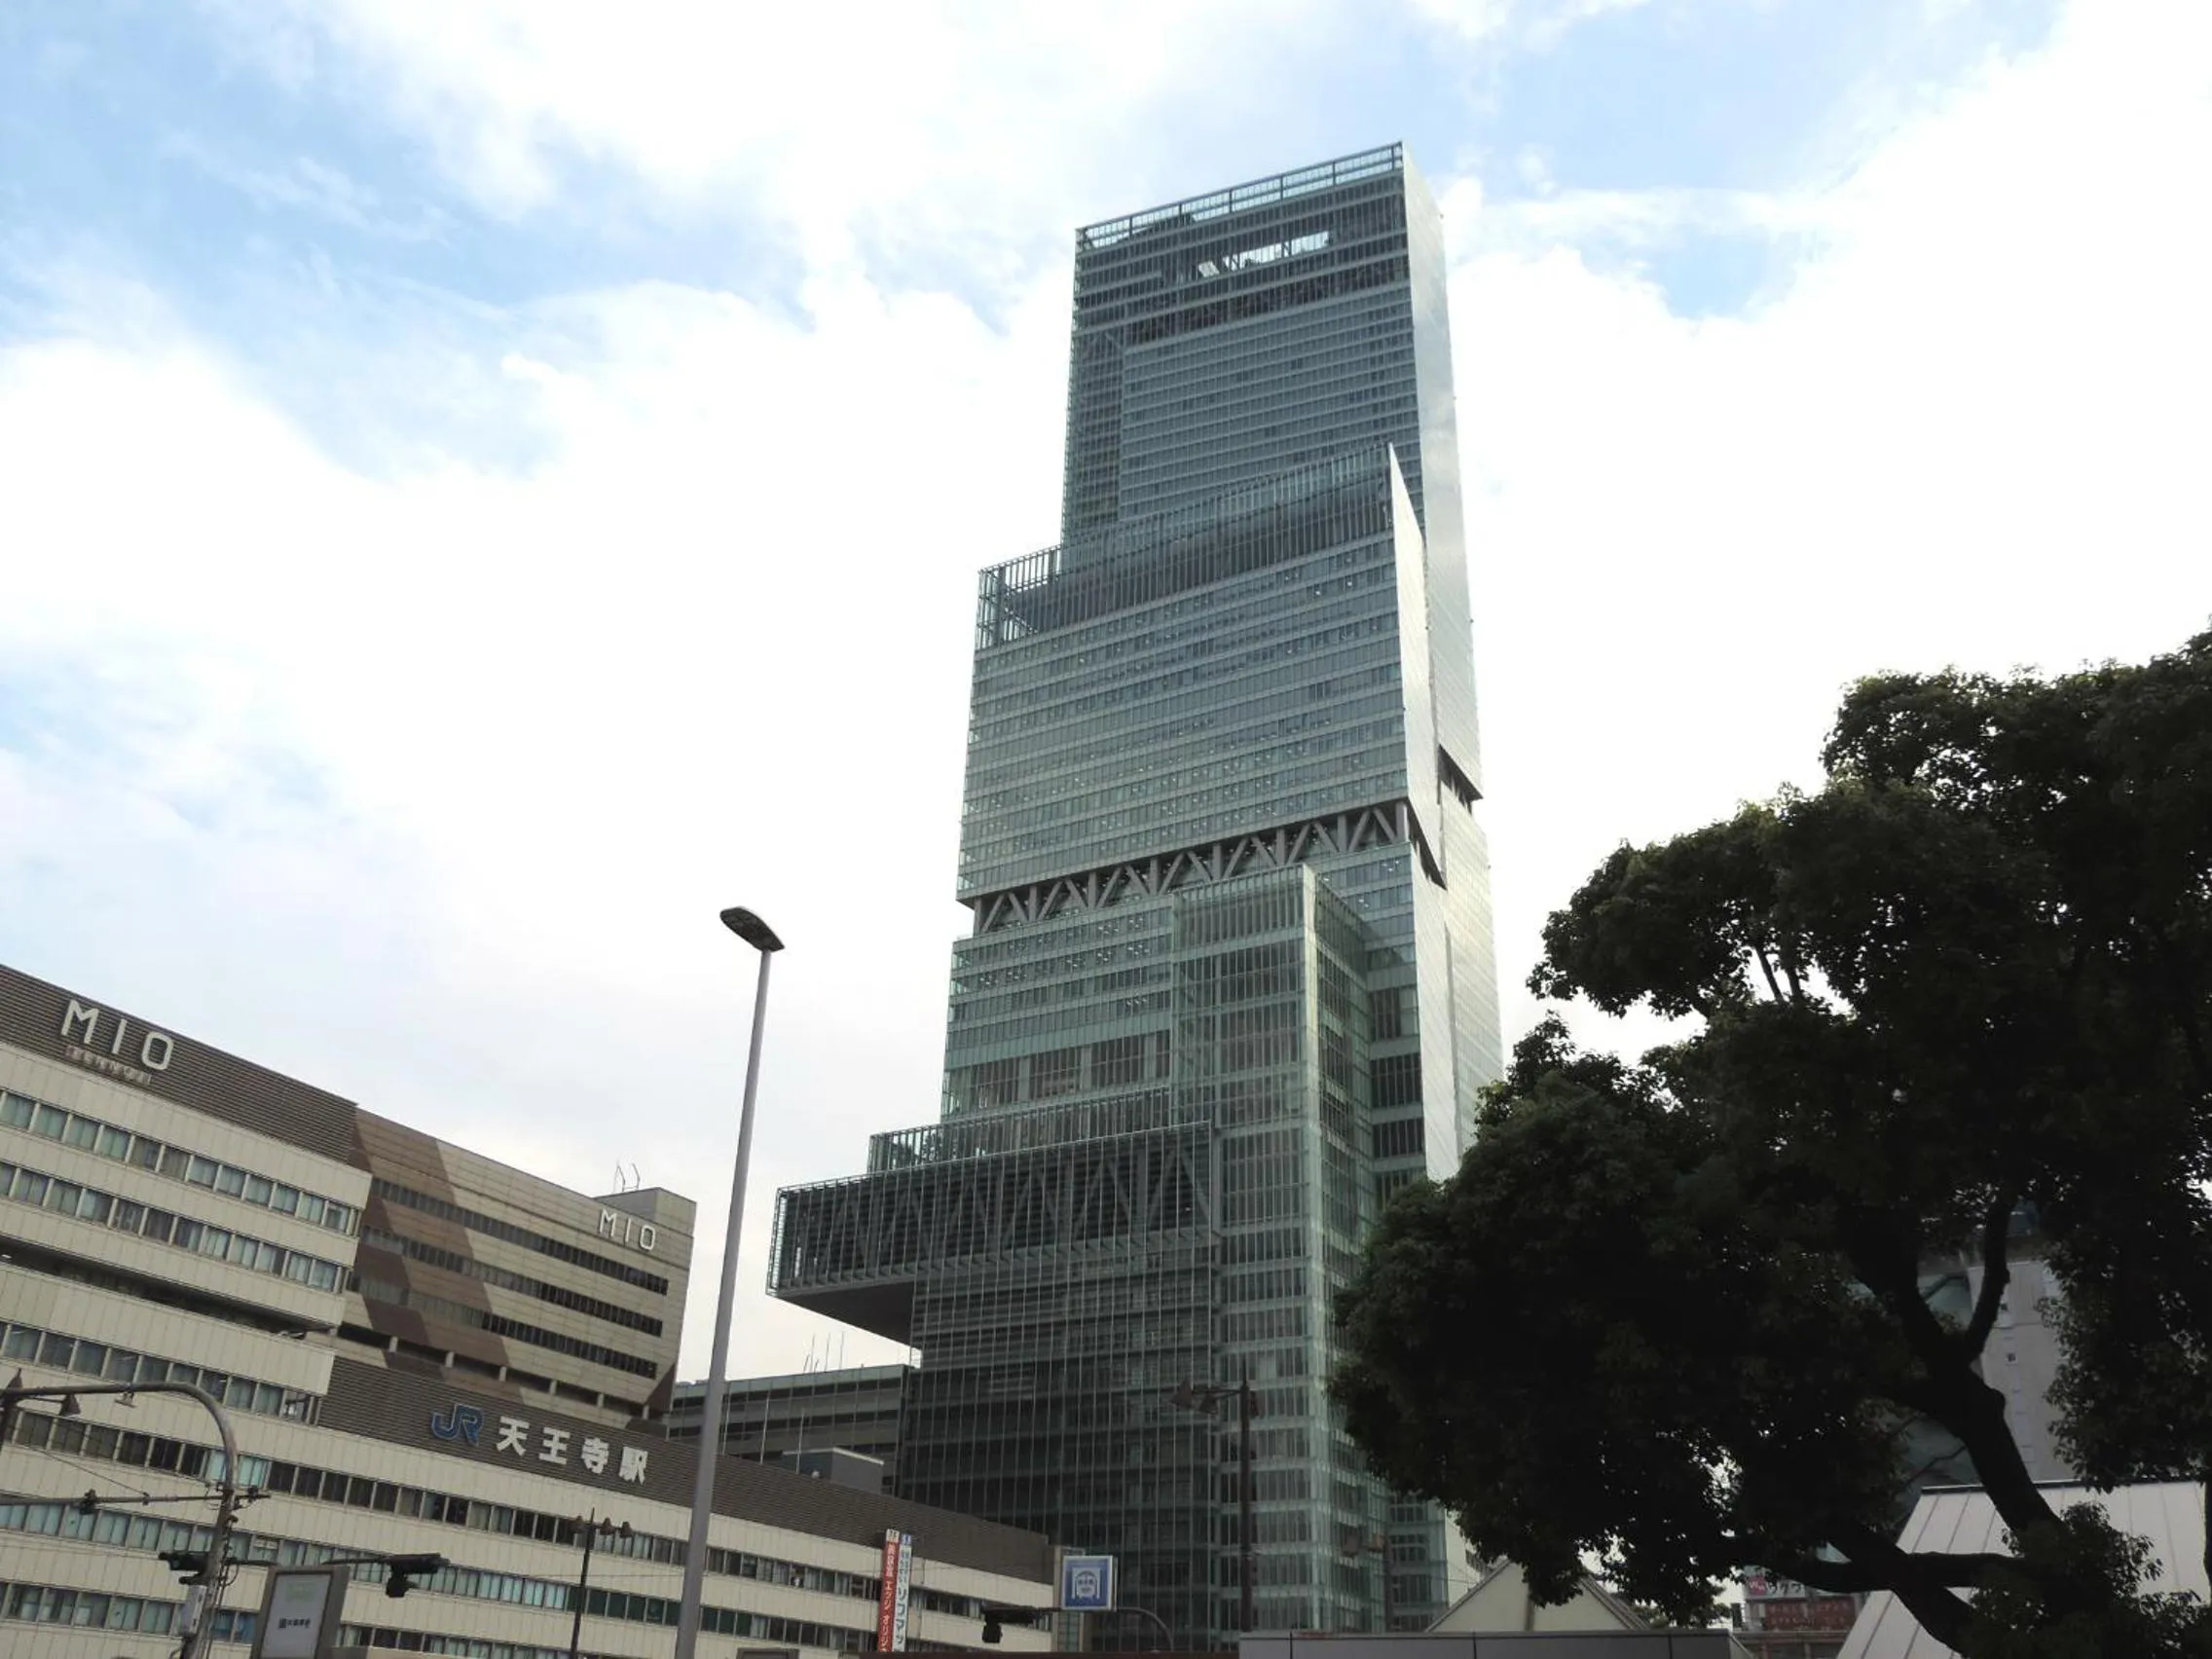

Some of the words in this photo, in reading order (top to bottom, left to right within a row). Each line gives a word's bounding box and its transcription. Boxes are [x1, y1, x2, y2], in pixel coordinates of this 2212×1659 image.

[60, 999, 174, 1071] MIO
[598, 1208, 656, 1251] MIO
[429, 1403, 484, 1447] JR
[497, 1416, 648, 1485] 天王寺駅
